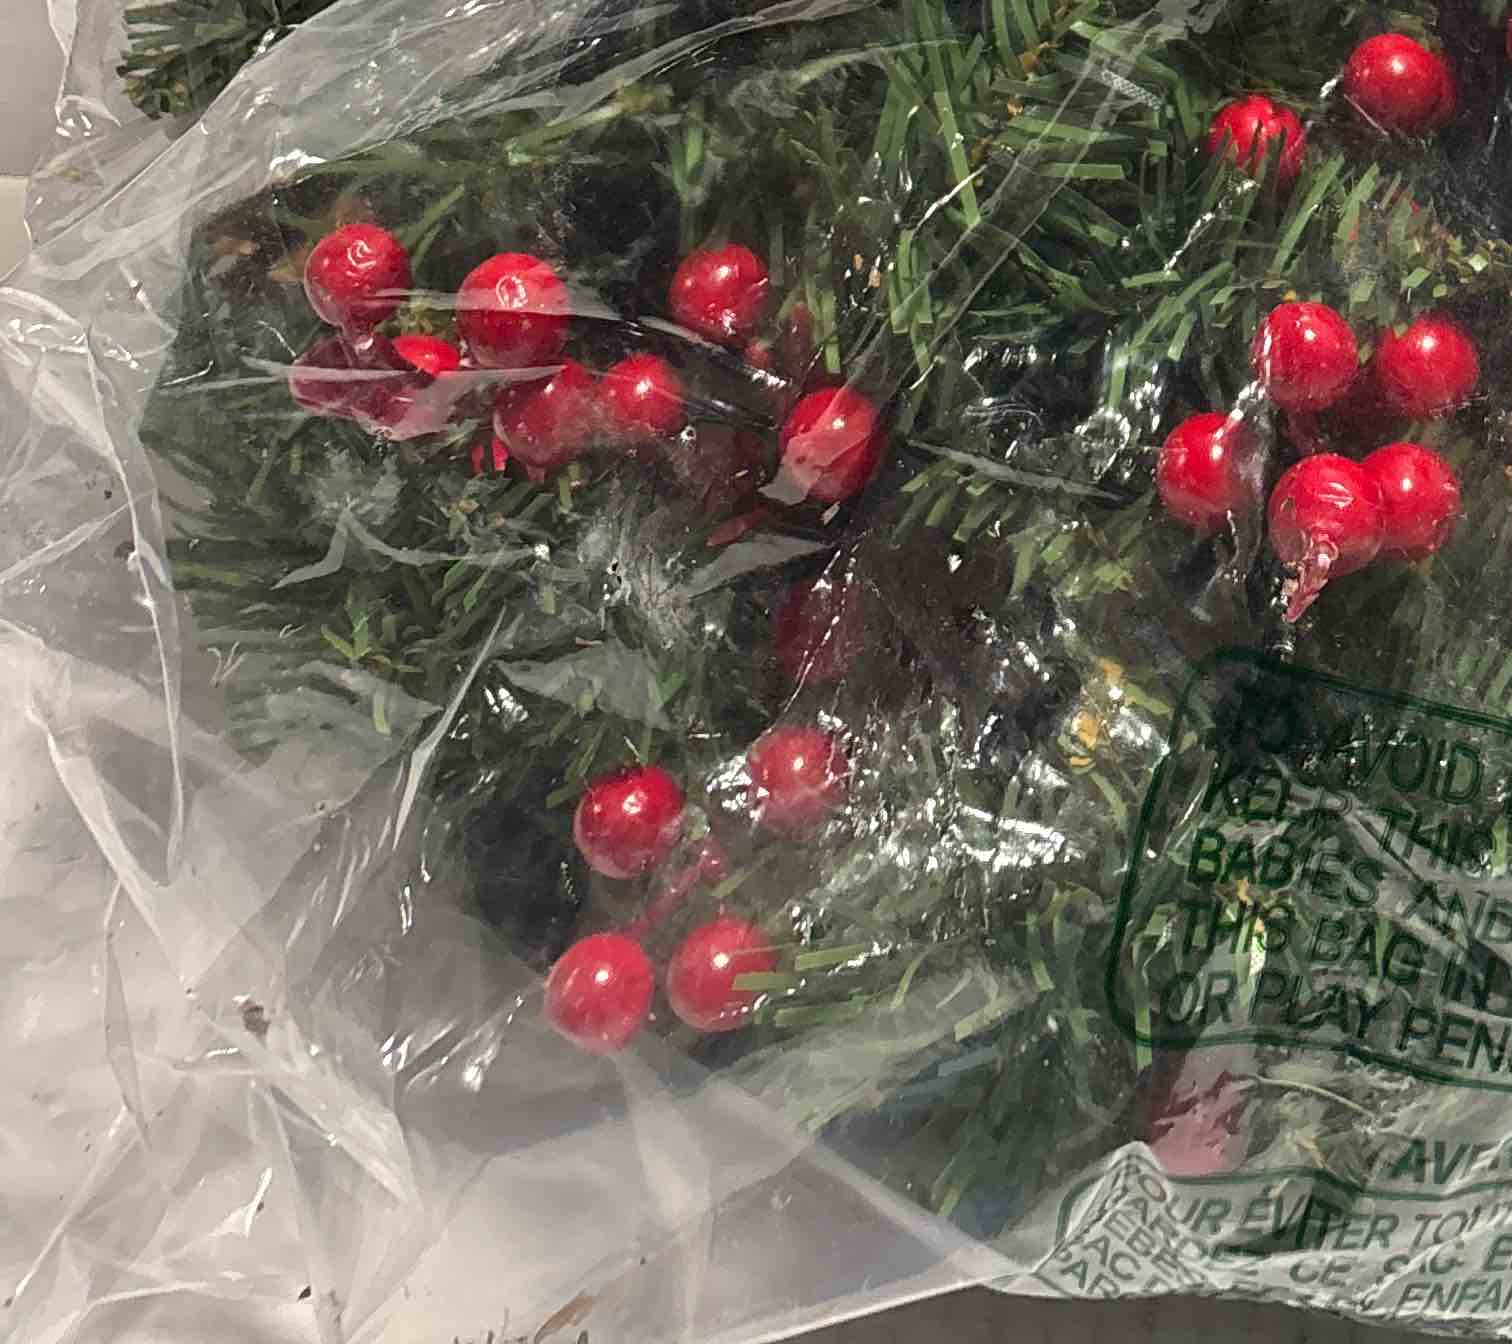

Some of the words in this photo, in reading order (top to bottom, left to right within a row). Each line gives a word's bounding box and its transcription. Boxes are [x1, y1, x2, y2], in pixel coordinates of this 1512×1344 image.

[1358, 734, 1484, 805] VOID
[1311, 916, 1426, 985] BAG
[1166, 970, 1233, 1023] OR
